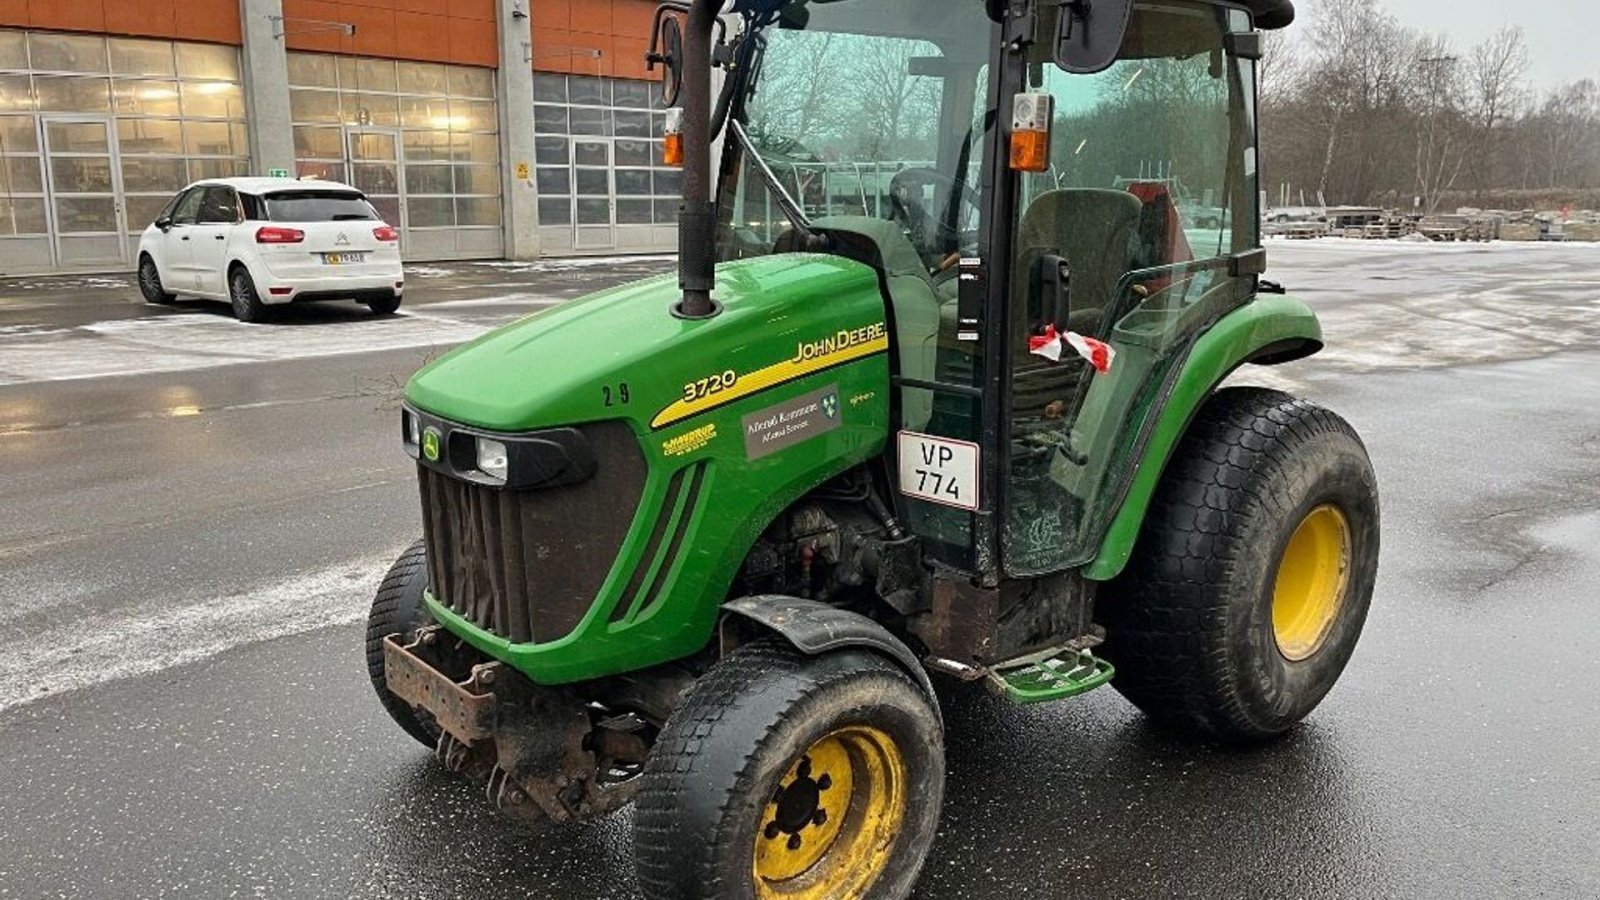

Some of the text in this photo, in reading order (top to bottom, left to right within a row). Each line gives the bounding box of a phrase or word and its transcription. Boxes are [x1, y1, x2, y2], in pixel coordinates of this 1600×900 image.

[793, 321, 884, 362] JOHN DEERE
[684, 369, 736, 402] 3720
[921, 442, 953, 468] VP
[915, 468, 959, 499] 774
